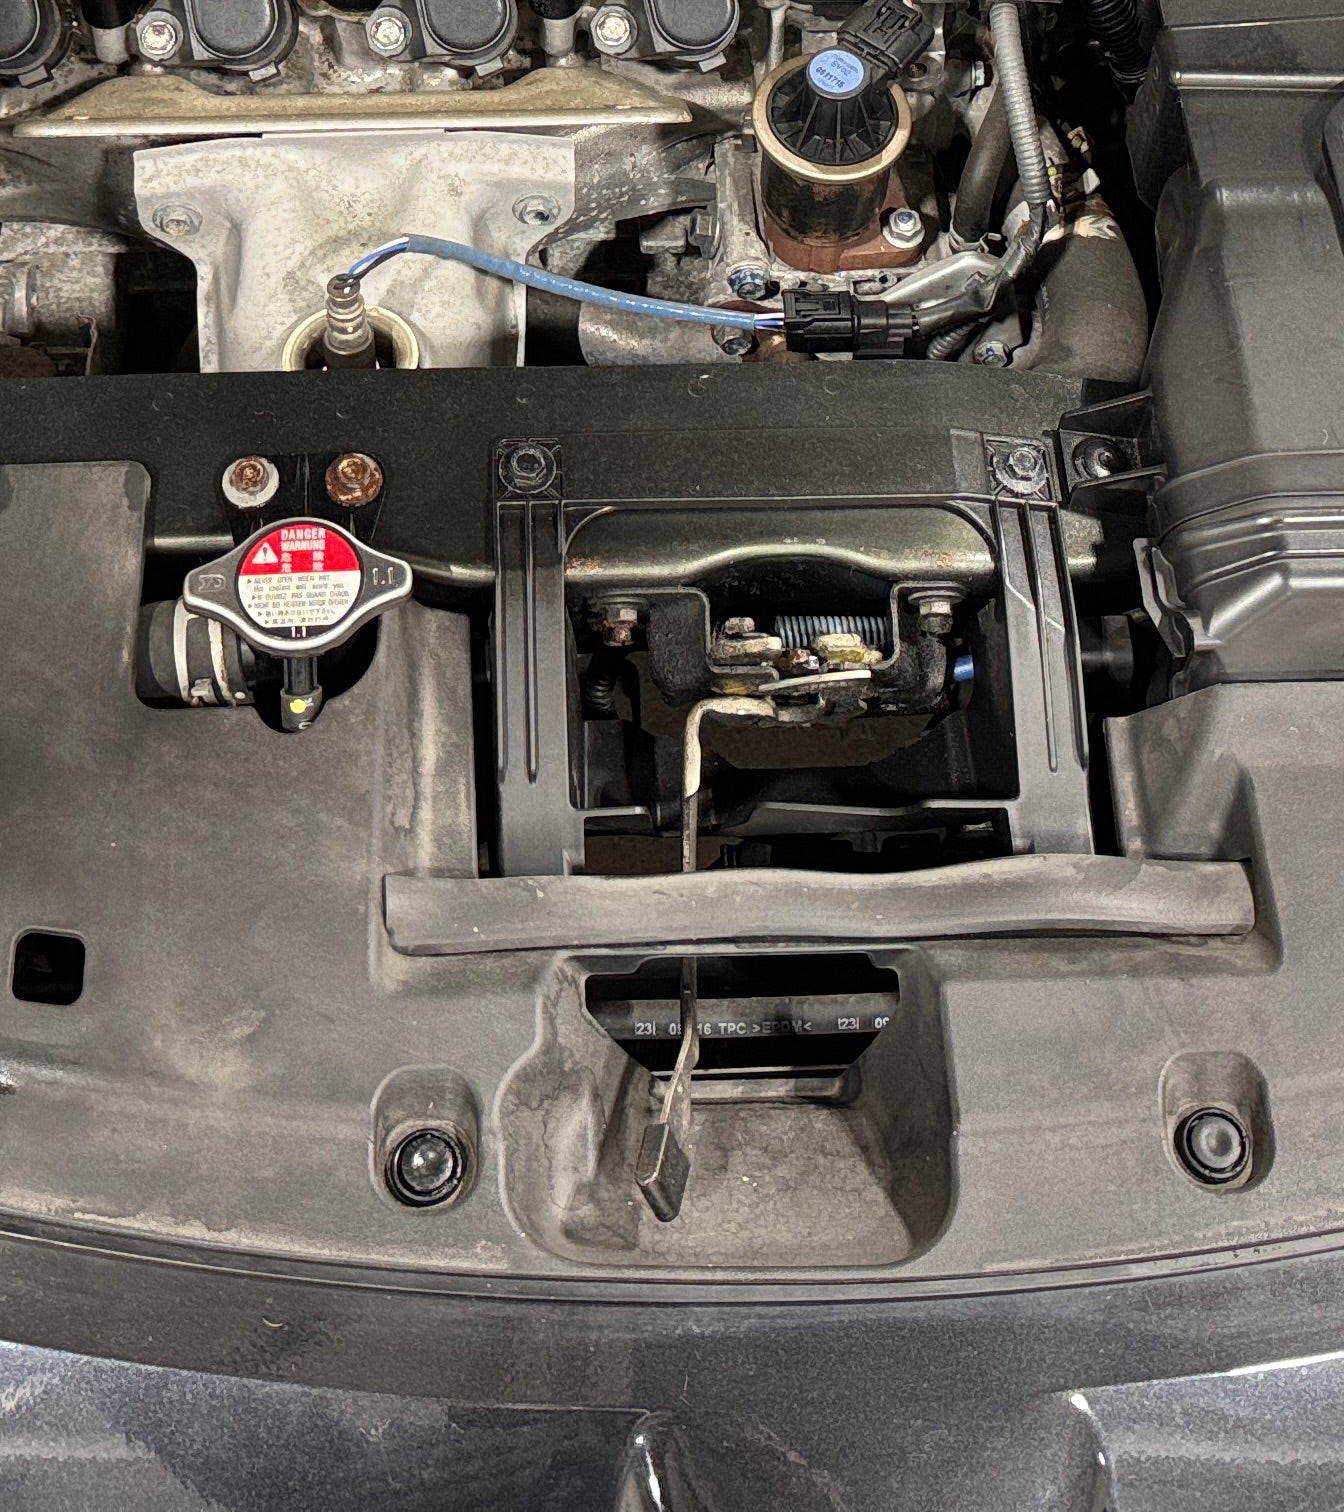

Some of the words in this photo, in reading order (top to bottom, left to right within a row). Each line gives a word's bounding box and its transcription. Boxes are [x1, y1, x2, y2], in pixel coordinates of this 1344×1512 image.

[281, 528, 326, 540] DANGER
[291, 626, 306, 637] 1.1
[718, 1022, 747, 1035] TPC
